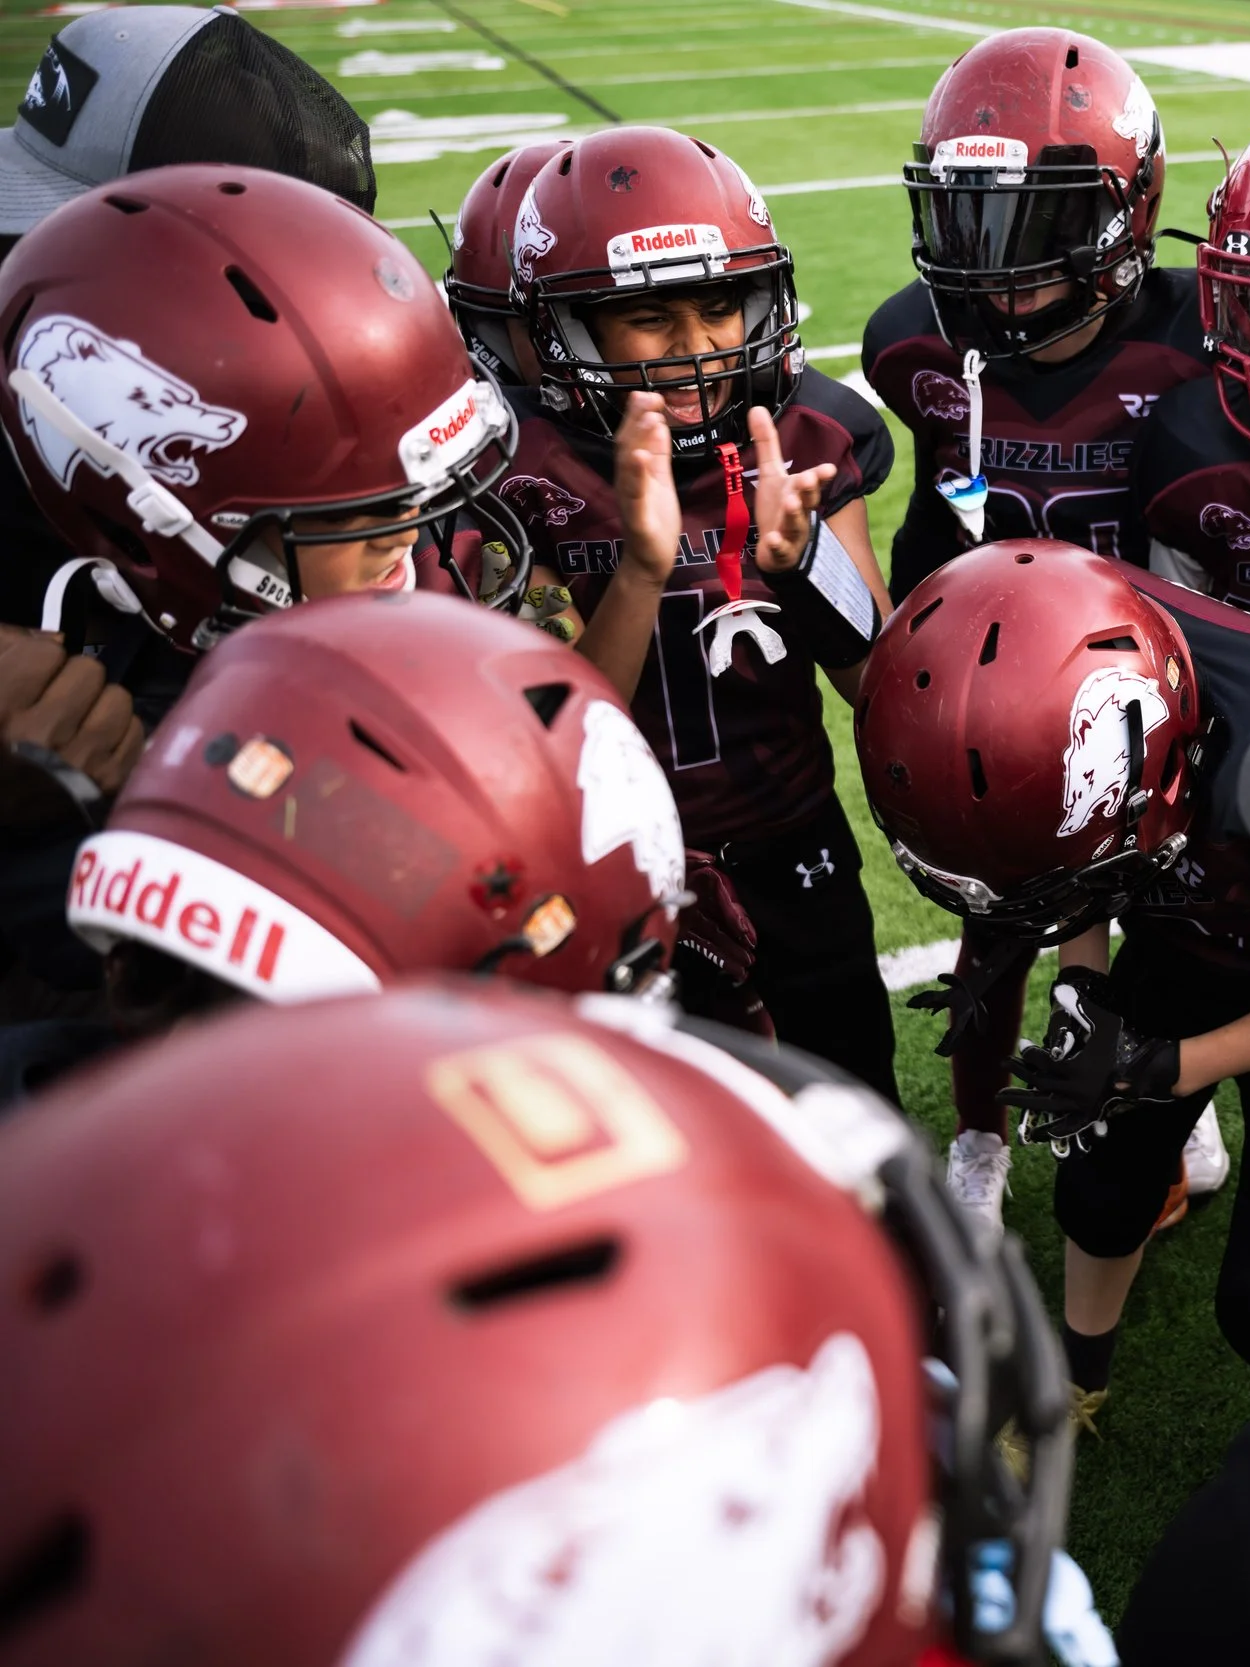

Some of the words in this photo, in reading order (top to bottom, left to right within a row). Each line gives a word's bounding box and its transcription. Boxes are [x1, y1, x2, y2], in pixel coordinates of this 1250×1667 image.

[956, 142, 1005, 158] Riddell
[632, 228, 697, 253] Riddell
[679, 429, 718, 449] Riddll
[69, 849, 286, 983] Riddell
